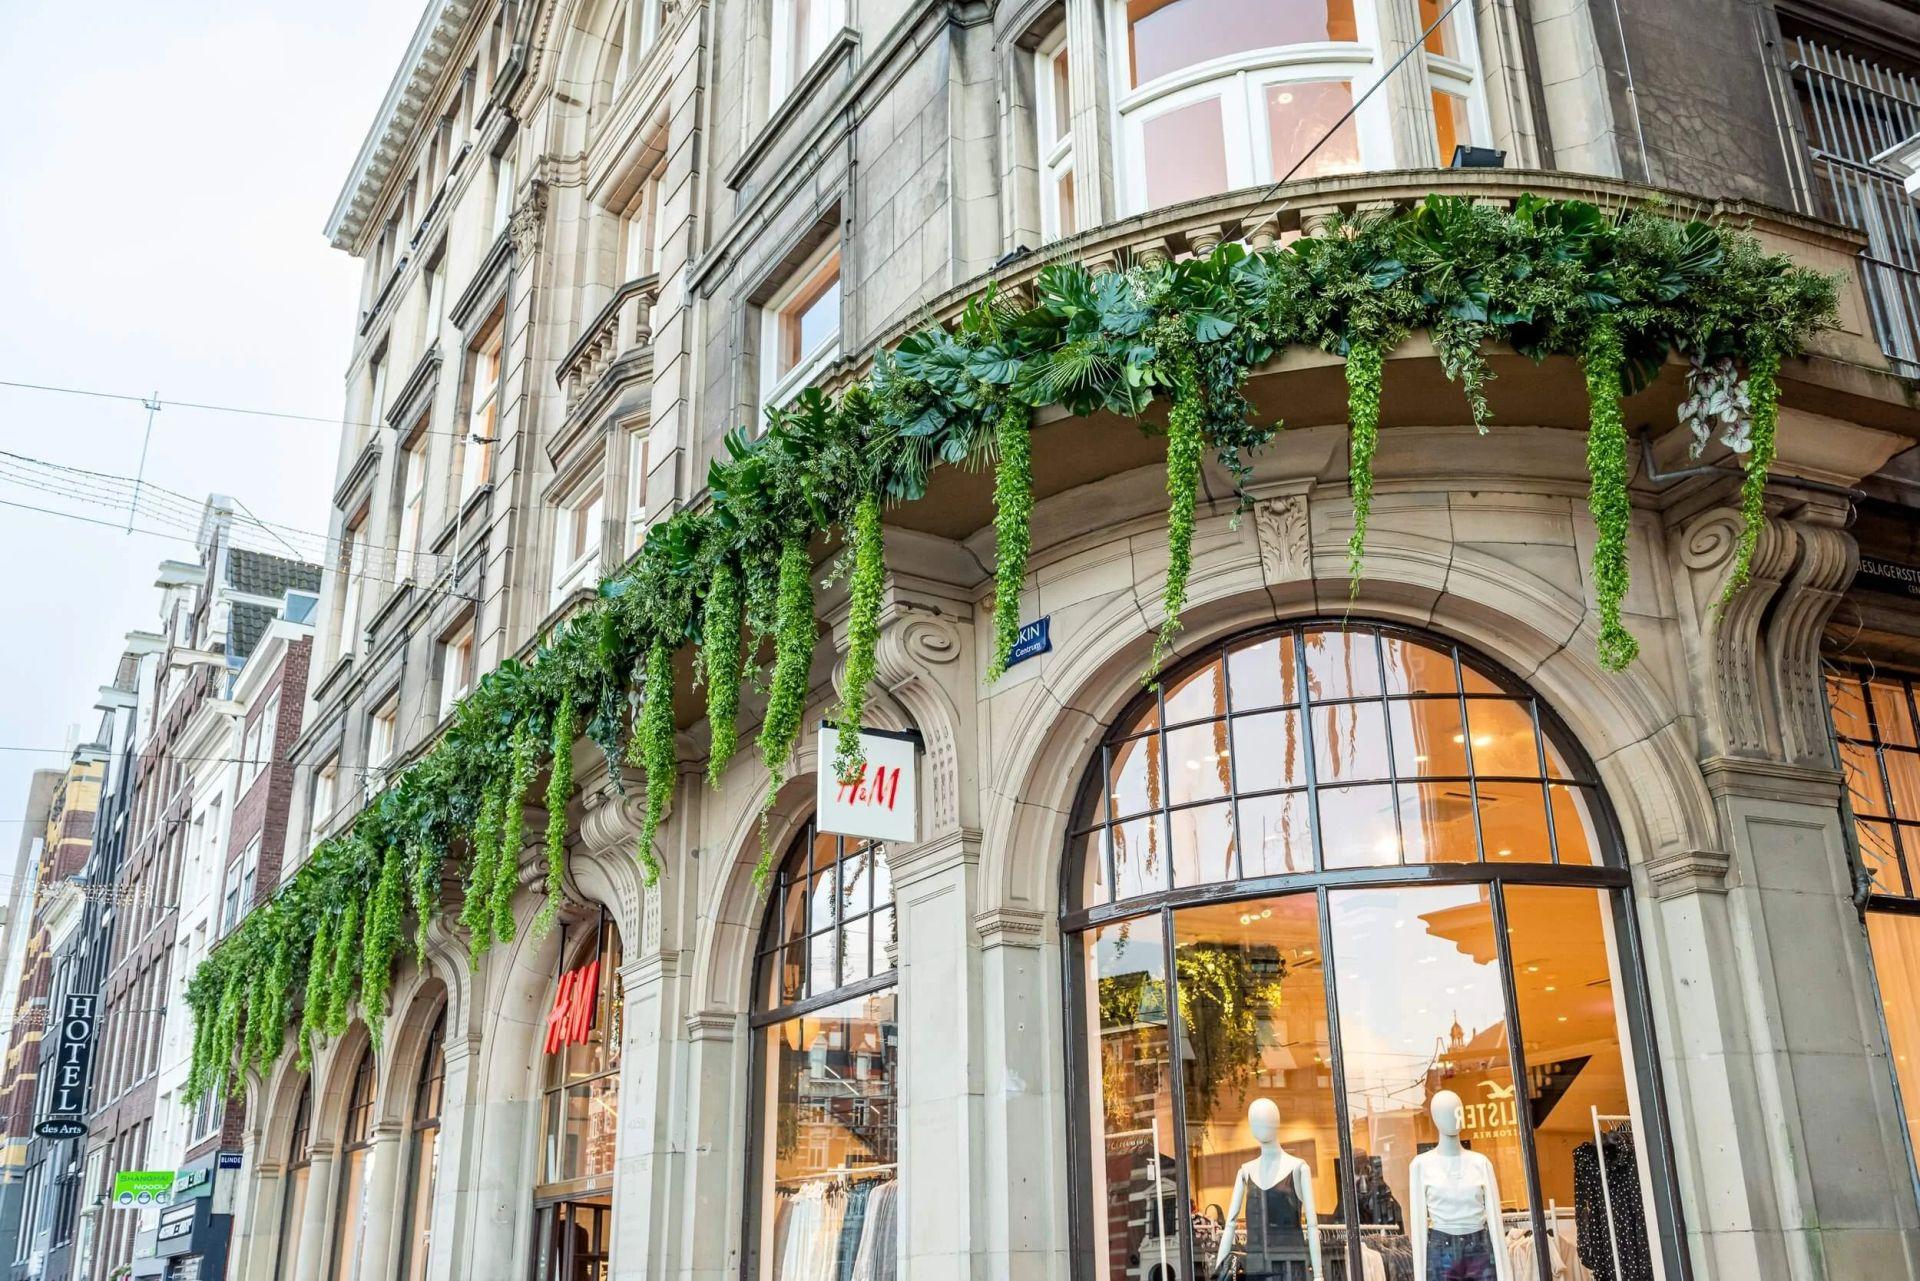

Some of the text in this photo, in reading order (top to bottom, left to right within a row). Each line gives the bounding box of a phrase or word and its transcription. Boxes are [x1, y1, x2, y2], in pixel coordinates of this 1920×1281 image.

[1015, 642, 1041, 657] Centrum
[837, 763, 901, 812] H&M
[58, 997, 93, 1111] HOTEL
[41, 1124, 82, 1134] des Arts
